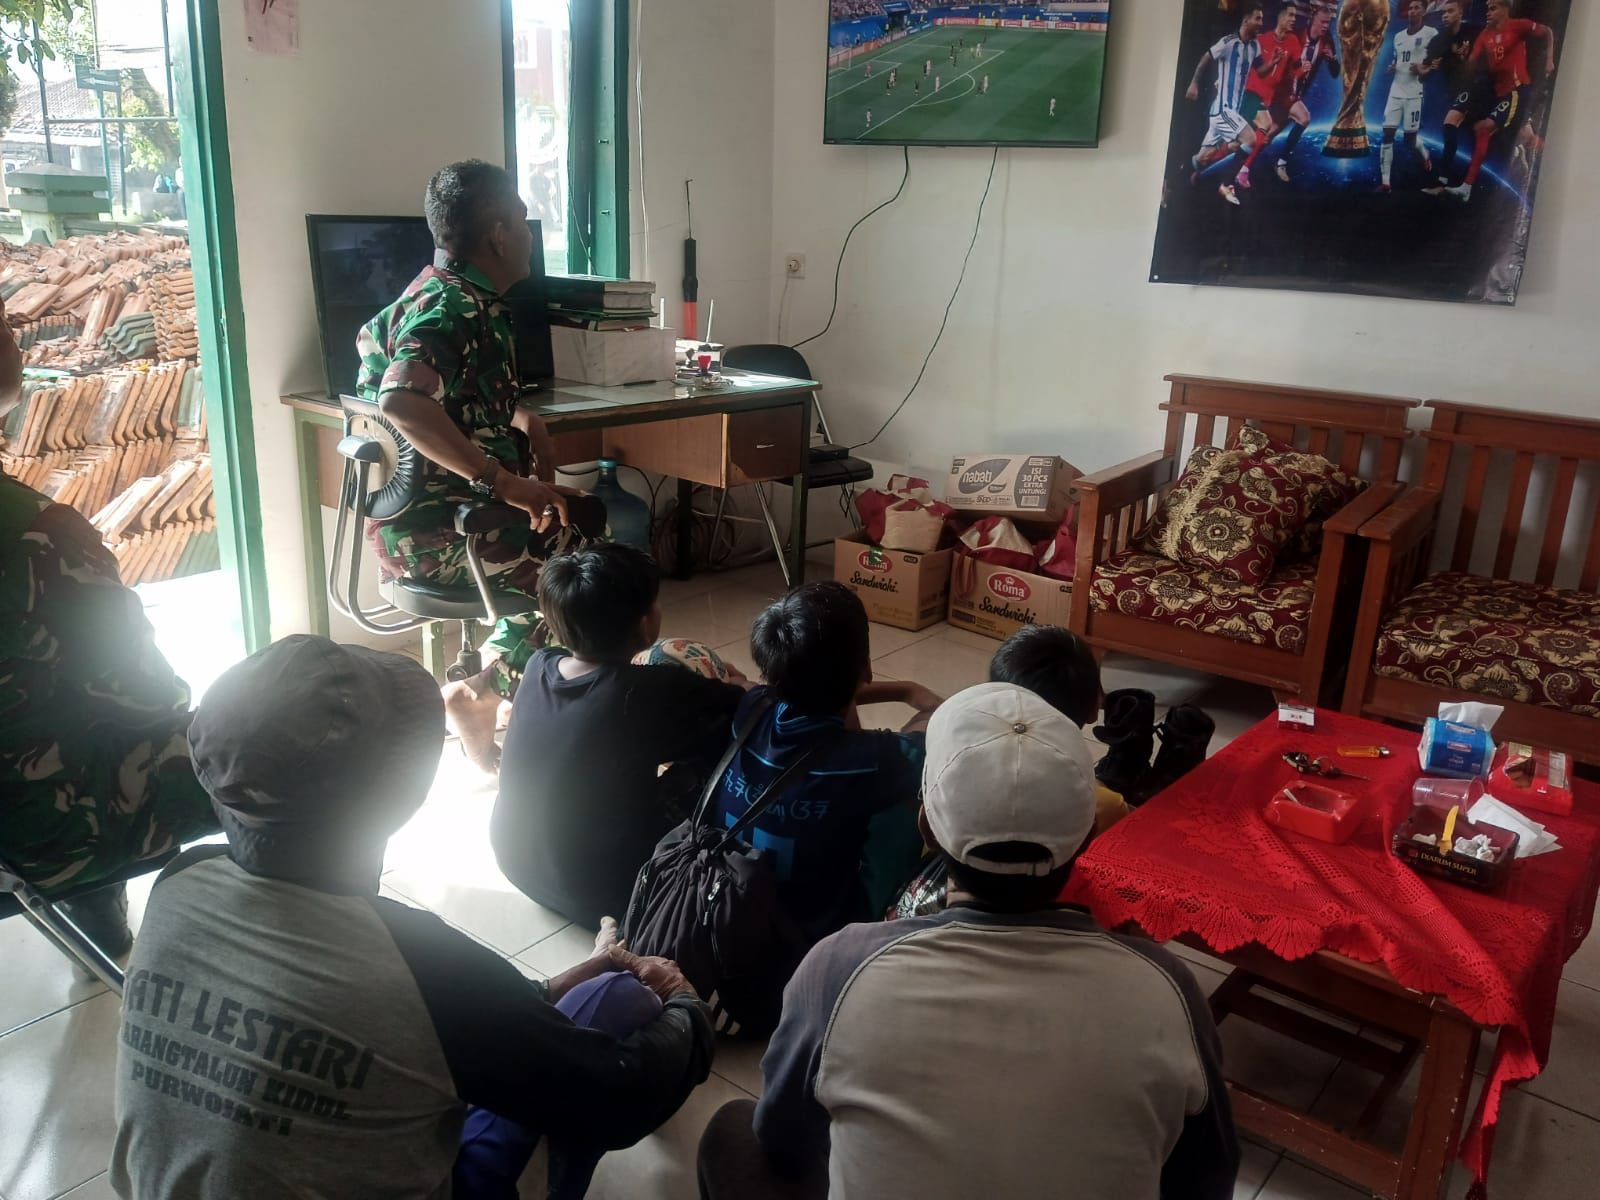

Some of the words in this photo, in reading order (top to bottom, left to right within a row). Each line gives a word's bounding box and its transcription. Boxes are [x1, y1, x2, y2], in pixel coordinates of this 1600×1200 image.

[1402, 50, 1411, 62] 10
[1411, 110, 1420, 122] 10
[1031, 467, 1042, 475] ISI
[1021, 474, 1032, 482] 30
[1033, 474, 1048, 482] PCS
[862, 555, 889, 570] Rma
[994, 579, 1025, 598] Roma
[191, 988, 375, 1090] LESTARI
